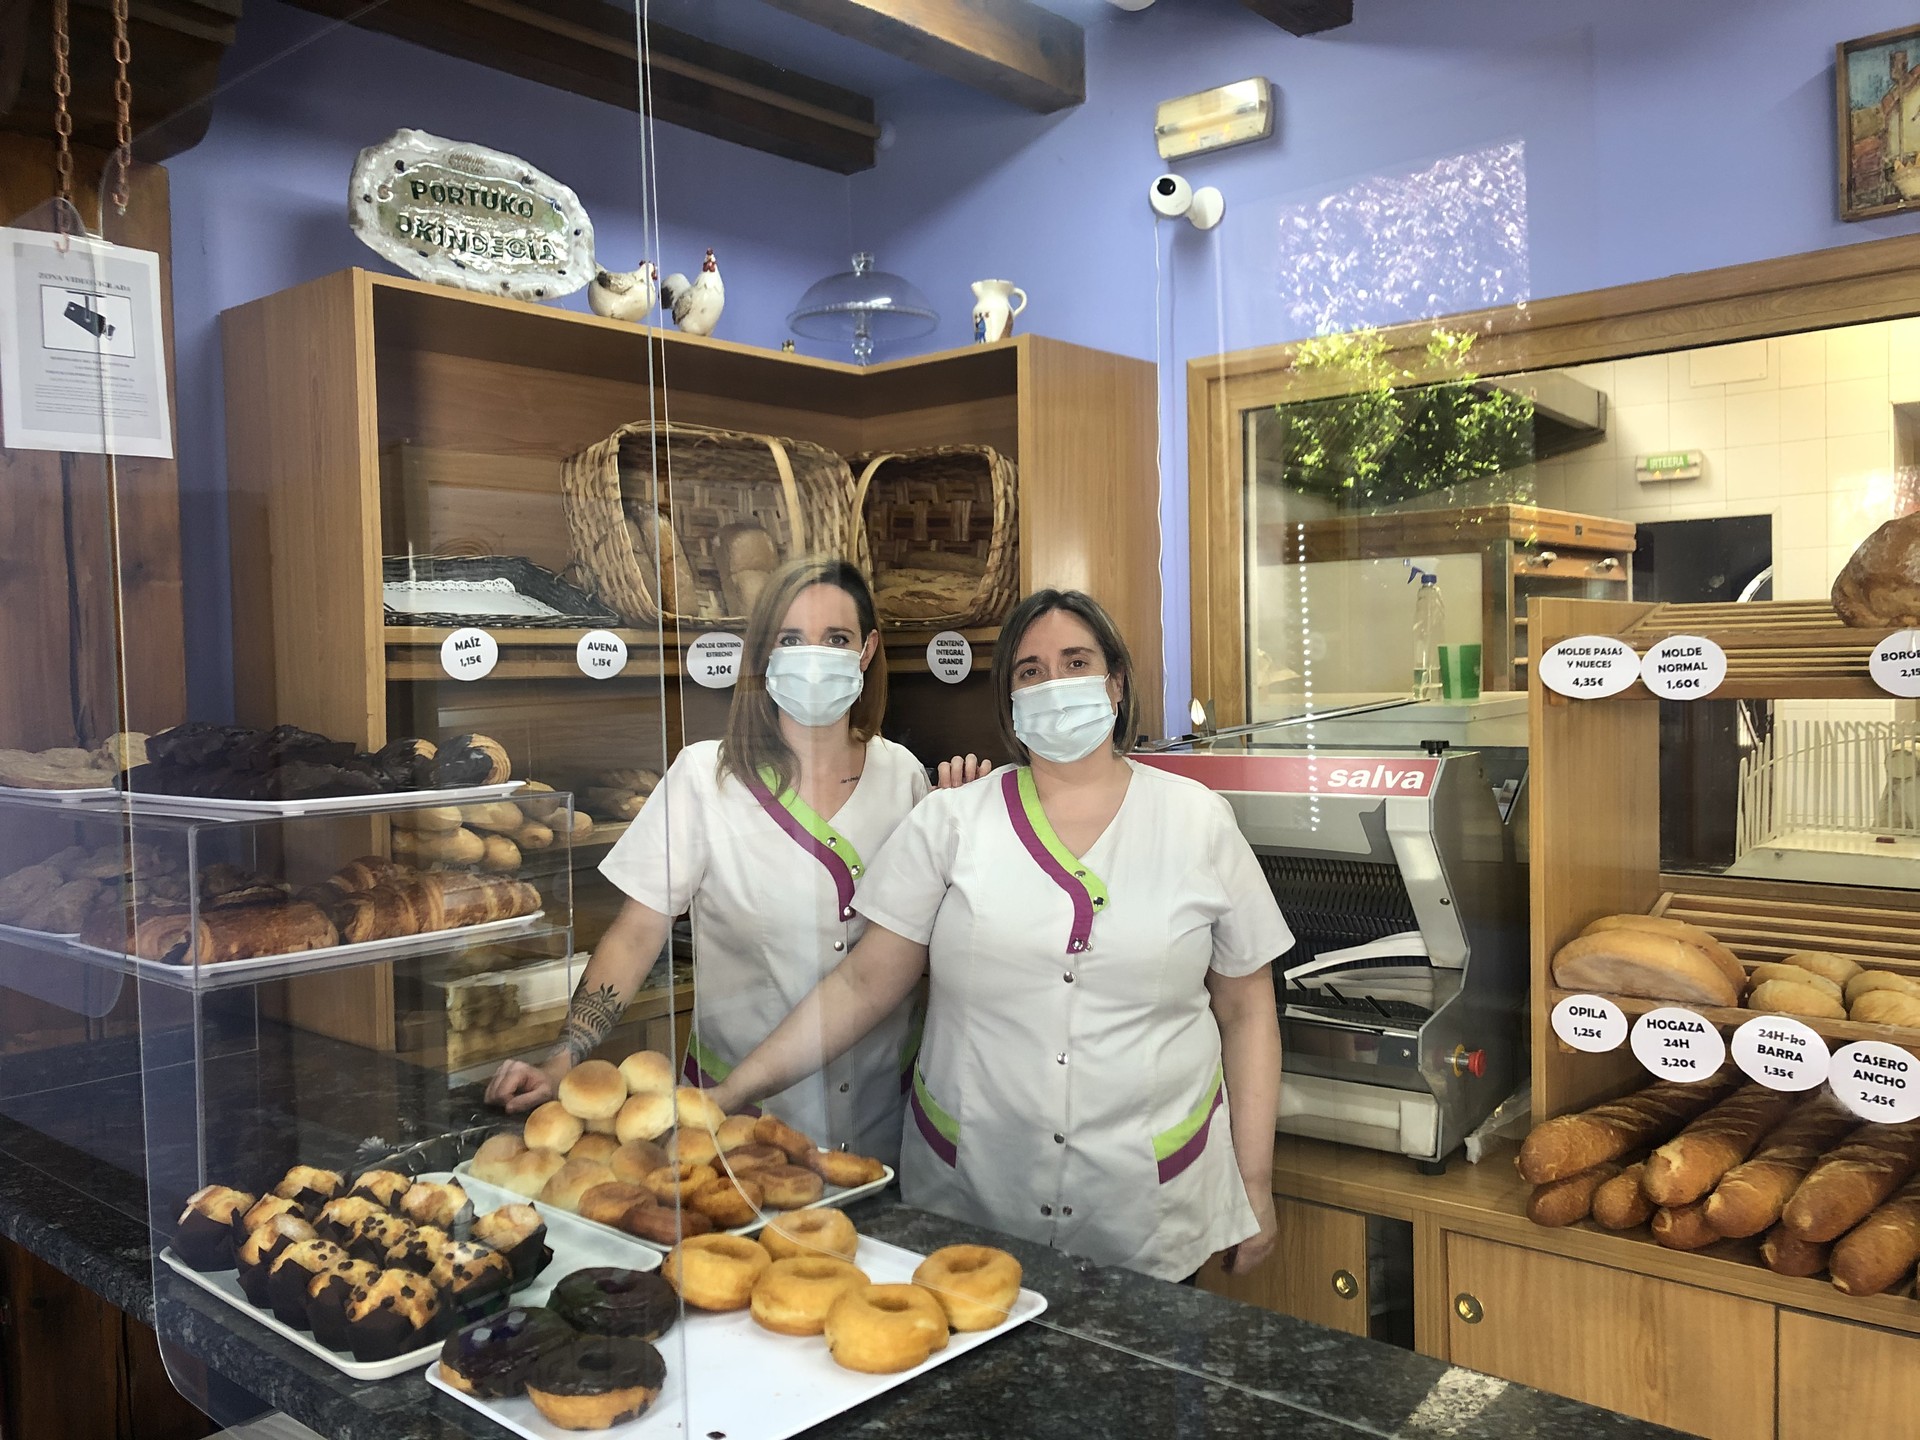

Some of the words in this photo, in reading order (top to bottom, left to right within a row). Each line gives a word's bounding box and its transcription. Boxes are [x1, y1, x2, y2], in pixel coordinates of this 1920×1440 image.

[410, 178, 534, 218] PORTUKO
[455, 636, 482, 651] MAÍZ
[587, 641, 619, 653] AVENA
[1557, 647, 1592, 656] MOLDE
[1593, 647, 1623, 656] PASAS
[1661, 647, 1703, 659] MOLDE
[460, 655, 482, 667] 1,15€
[592, 658, 611, 667] 1,15€
[1567, 660, 1574, 668] Y
[1575, 660, 1612, 669] NUECES
[1657, 661, 1708, 674] NORMAL
[707, 665, 732, 676] 2,10€
[1572, 677, 1604, 688] 4,35€
[1666, 678, 1700, 690] 1,60€
[1327, 764, 1425, 790] salva
[1568, 1005, 1608, 1020] OPILA
[1573, 1026, 1602, 1039] 1,25€
[1646, 1018, 1706, 1034] HOGAZA
[1663, 1038, 1690, 1049] 24H
[1757, 1043, 1804, 1063] BARRA
[1661, 1057, 1696, 1069] 3,20€
[1853, 1052, 1909, 1073] CASERO
[1763, 1065, 1794, 1080] 1,35€
[1853, 1069, 1907, 1089] ANCHO
[1860, 1091, 1896, 1108] 2,45€
